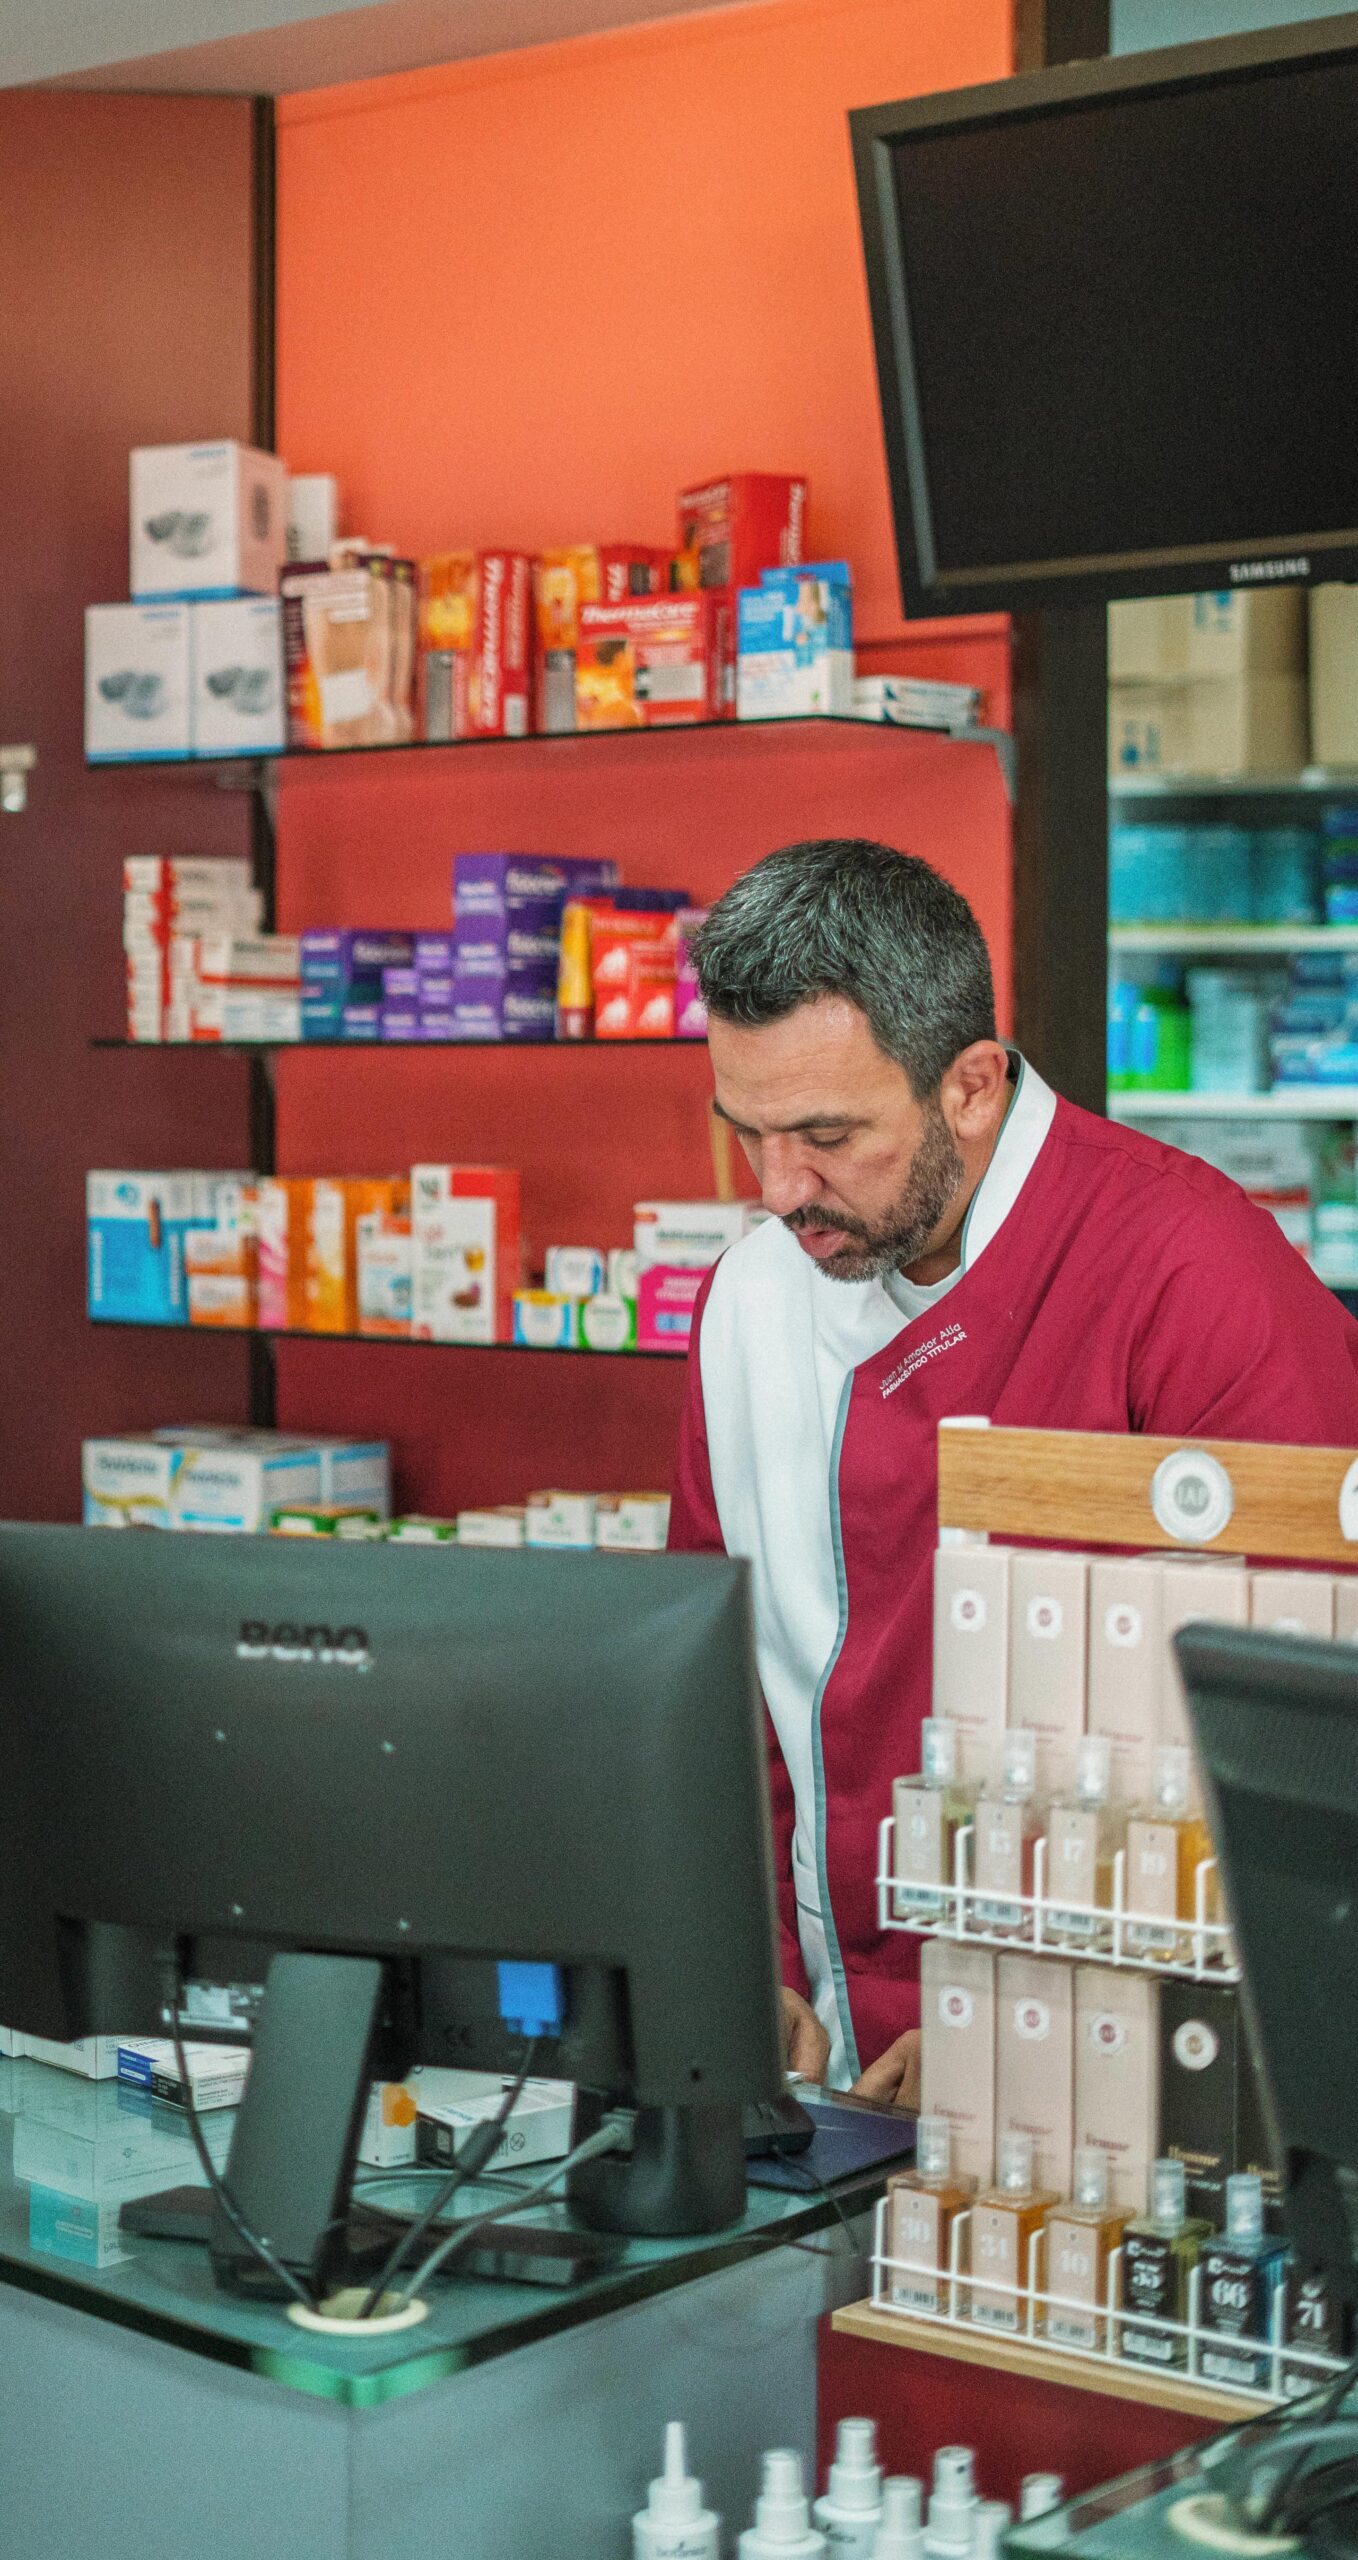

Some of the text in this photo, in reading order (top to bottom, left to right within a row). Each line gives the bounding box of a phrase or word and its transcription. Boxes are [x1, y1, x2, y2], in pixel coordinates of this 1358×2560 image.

[1229, 557, 1311, 583] SAMSUNG
[903, 1336, 938, 1366] Amador
[926, 1331, 968, 1359] TITULAR
[1212, 2278, 1248, 2310] 66
[1297, 2300, 1323, 2330] 71
